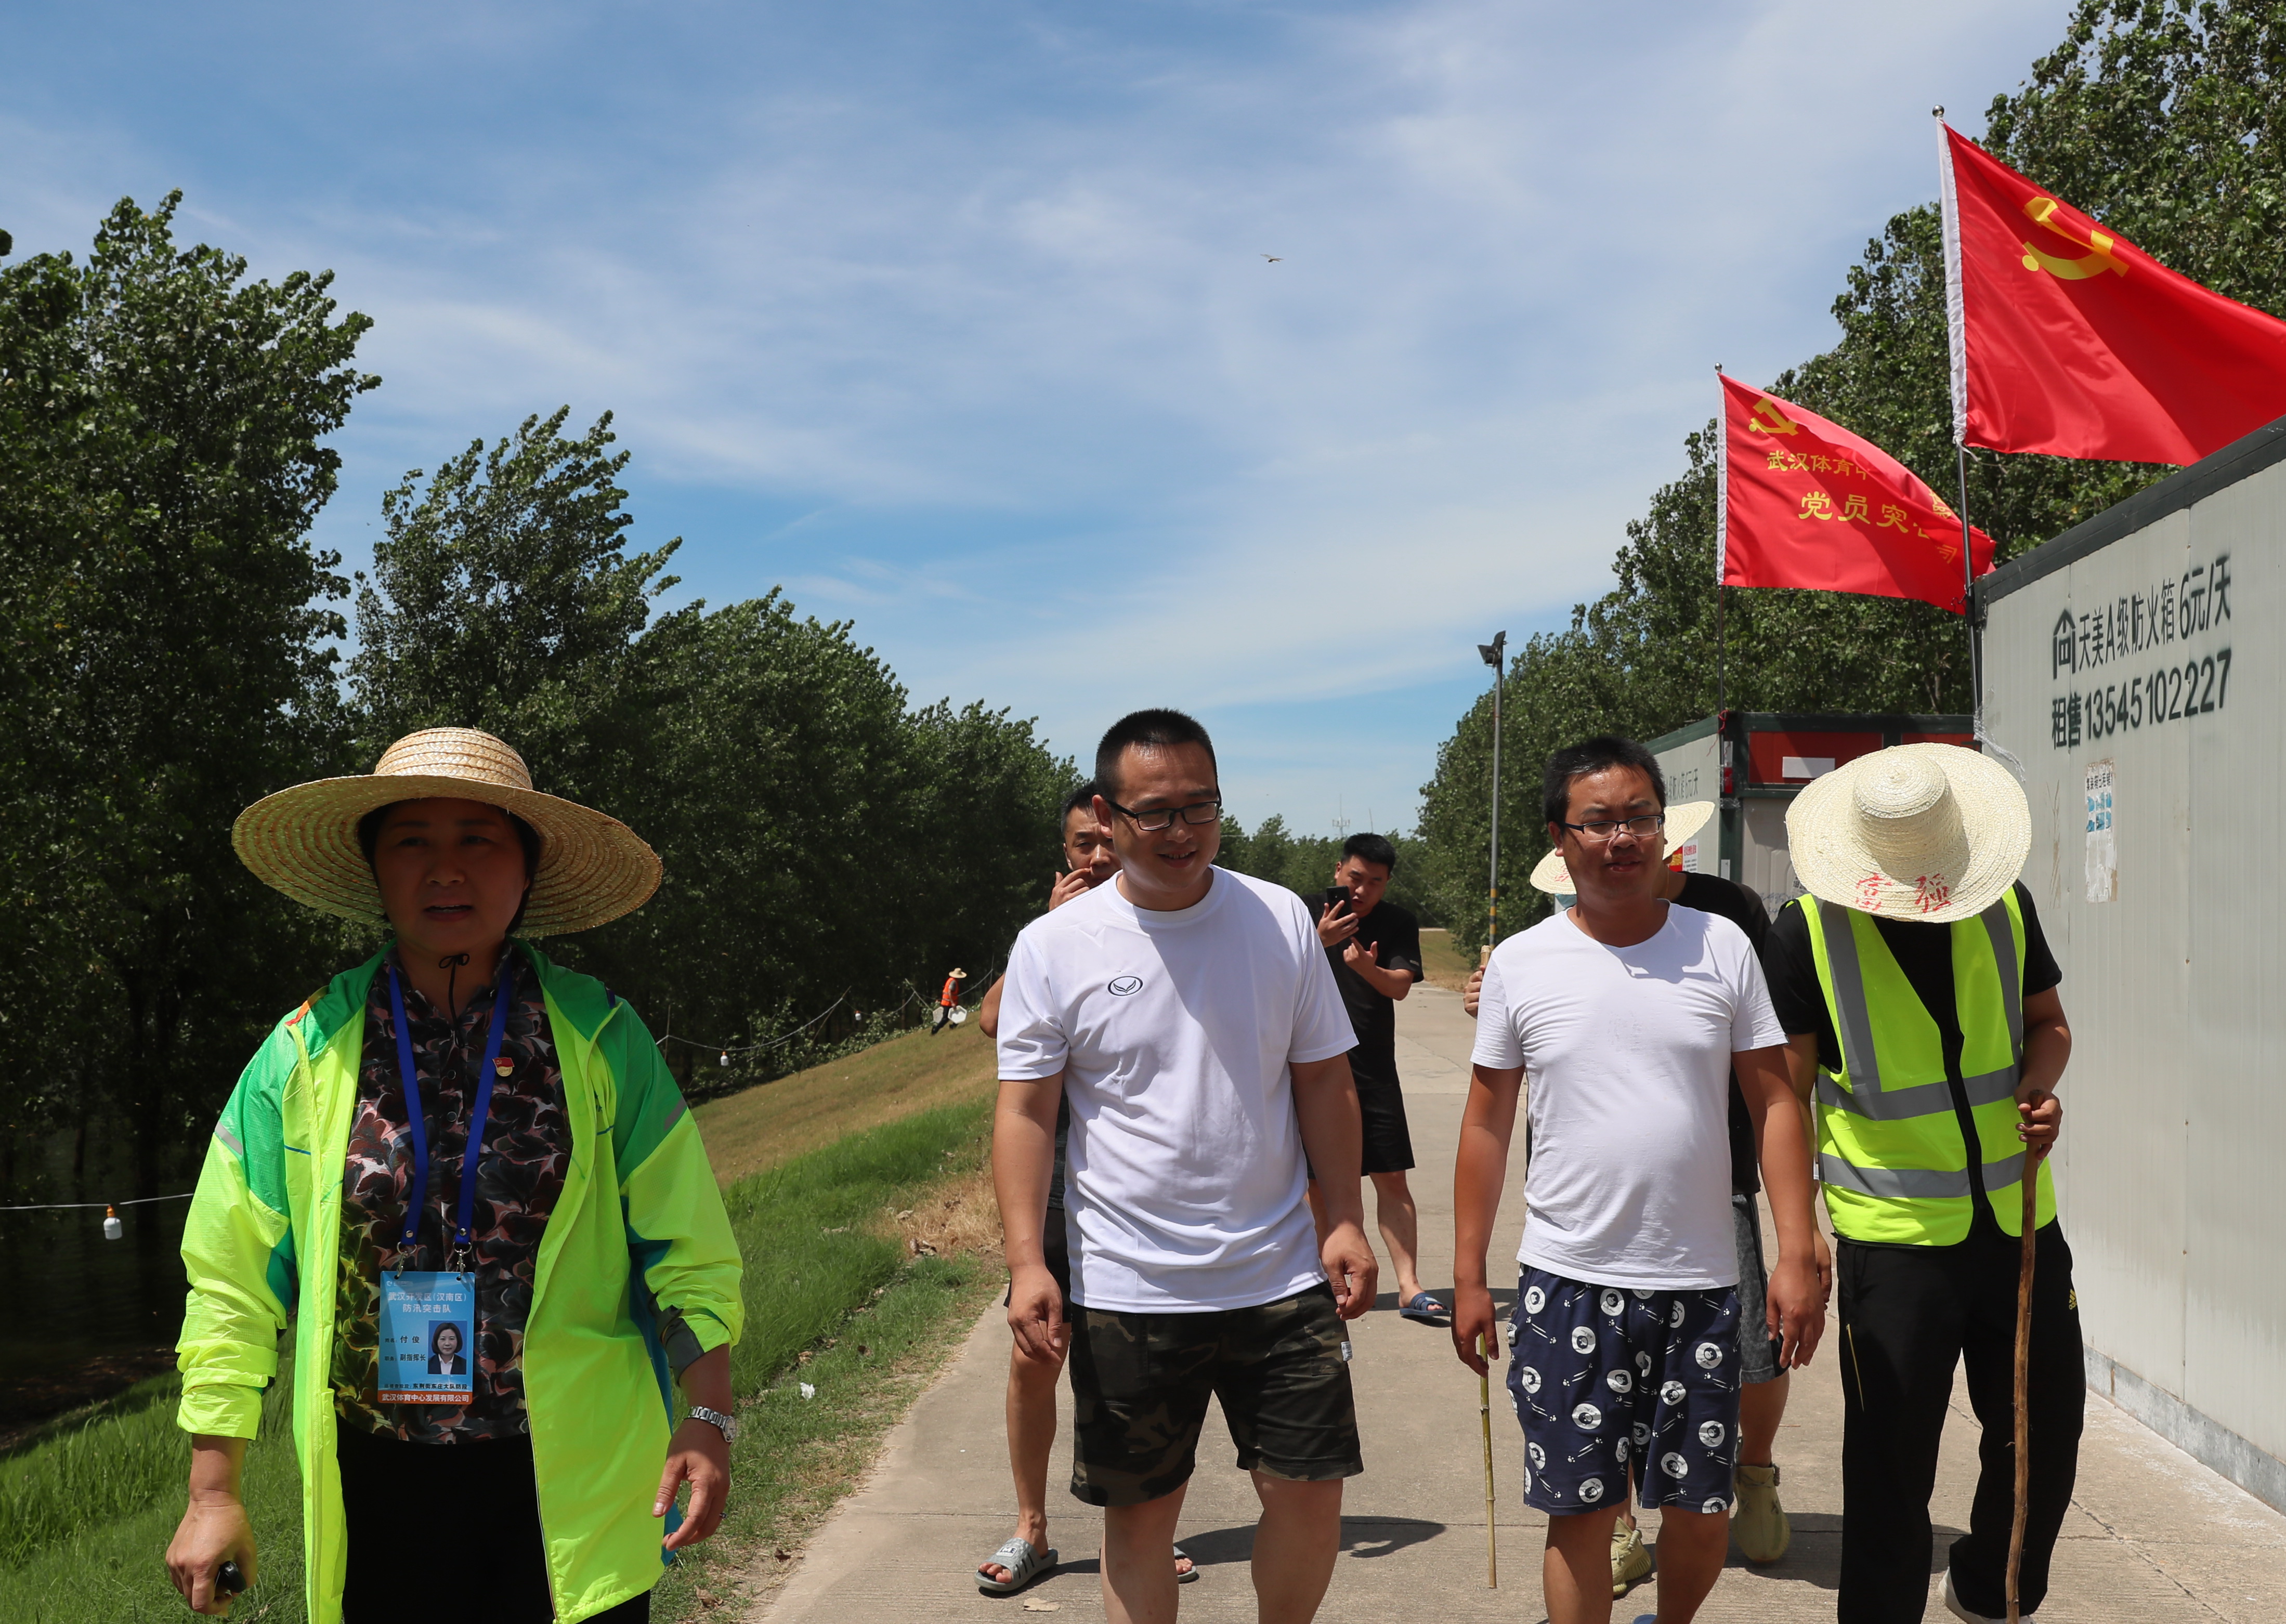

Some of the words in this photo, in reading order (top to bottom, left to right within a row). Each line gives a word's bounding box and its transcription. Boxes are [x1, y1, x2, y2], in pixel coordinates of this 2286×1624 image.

[1798, 491, 1930, 539] 党员突
[402, 1304, 451, 1313] 防汛突击队
[382, 1394, 469, 1403] 武汉体育中心发展有限公司
